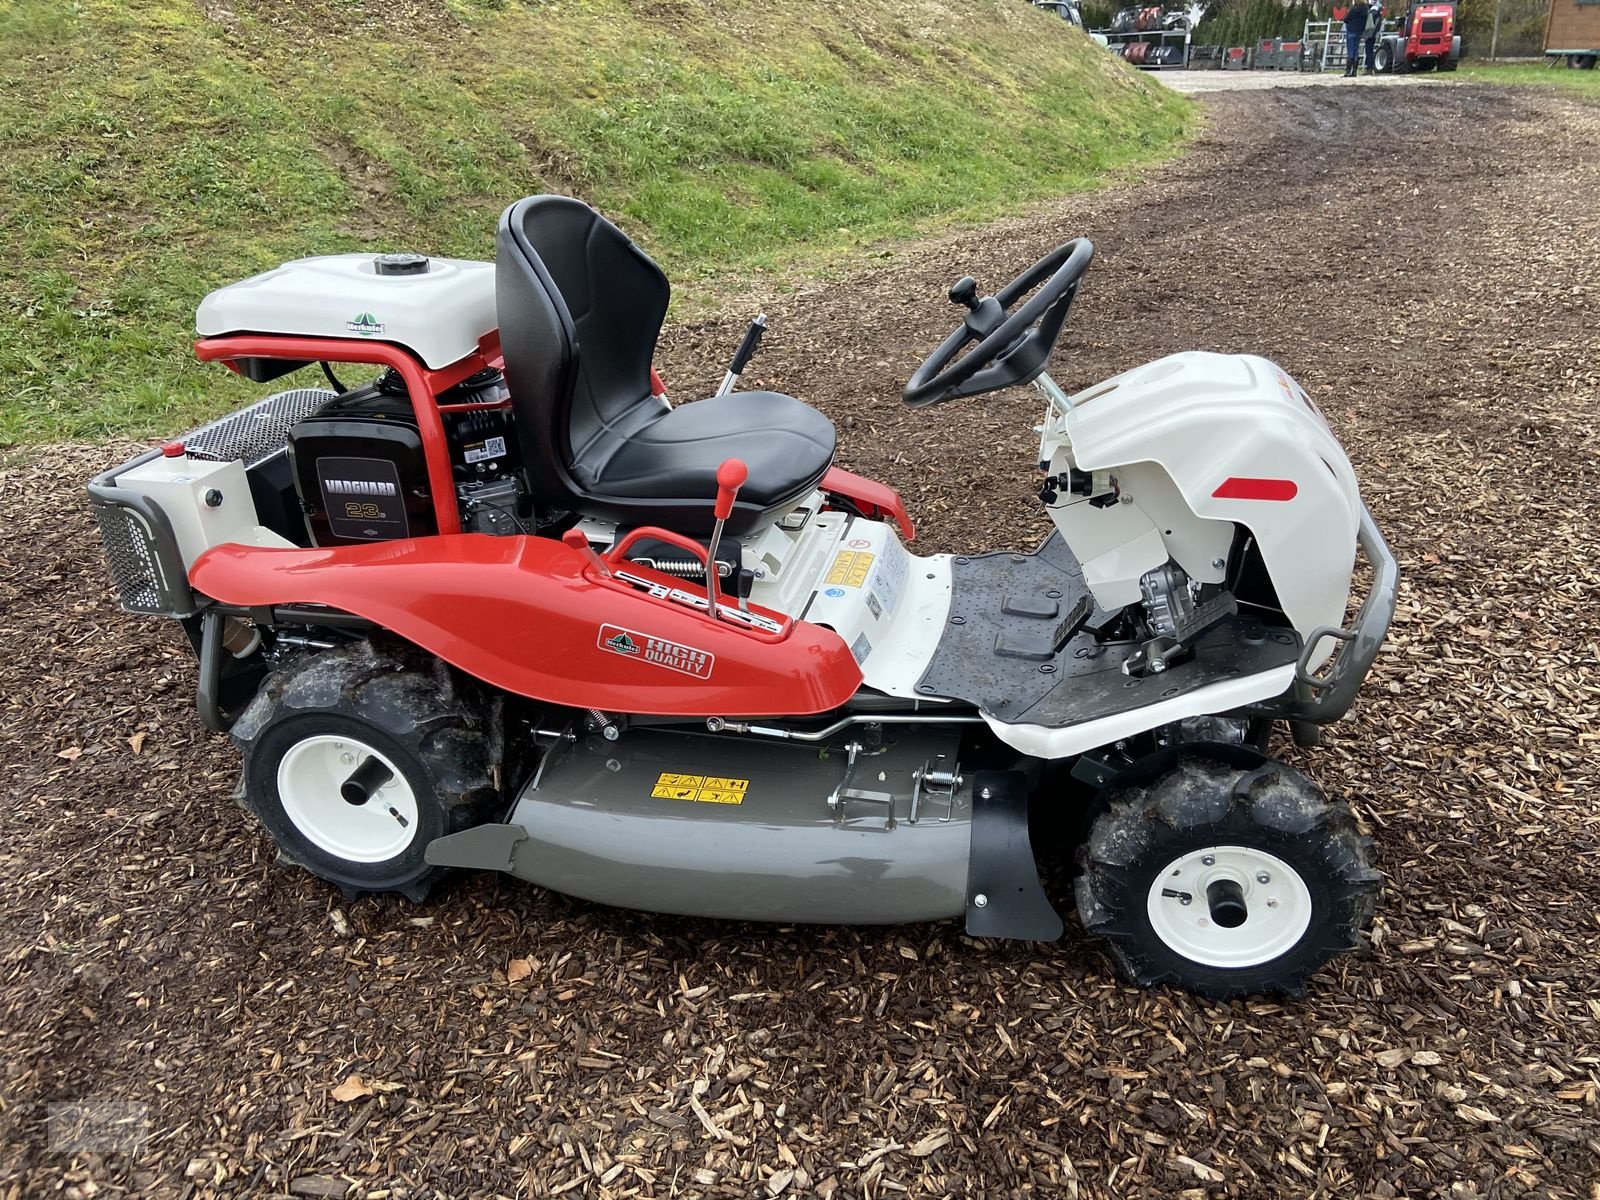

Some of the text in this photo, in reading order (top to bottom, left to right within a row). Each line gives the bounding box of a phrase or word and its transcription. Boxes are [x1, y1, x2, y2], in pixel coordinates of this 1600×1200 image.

[325, 479, 396, 496] VANGUARD
[345, 502, 379, 518] 23
[644, 649, 704, 673] QUALITY
[646, 639, 706, 664] HIGH
